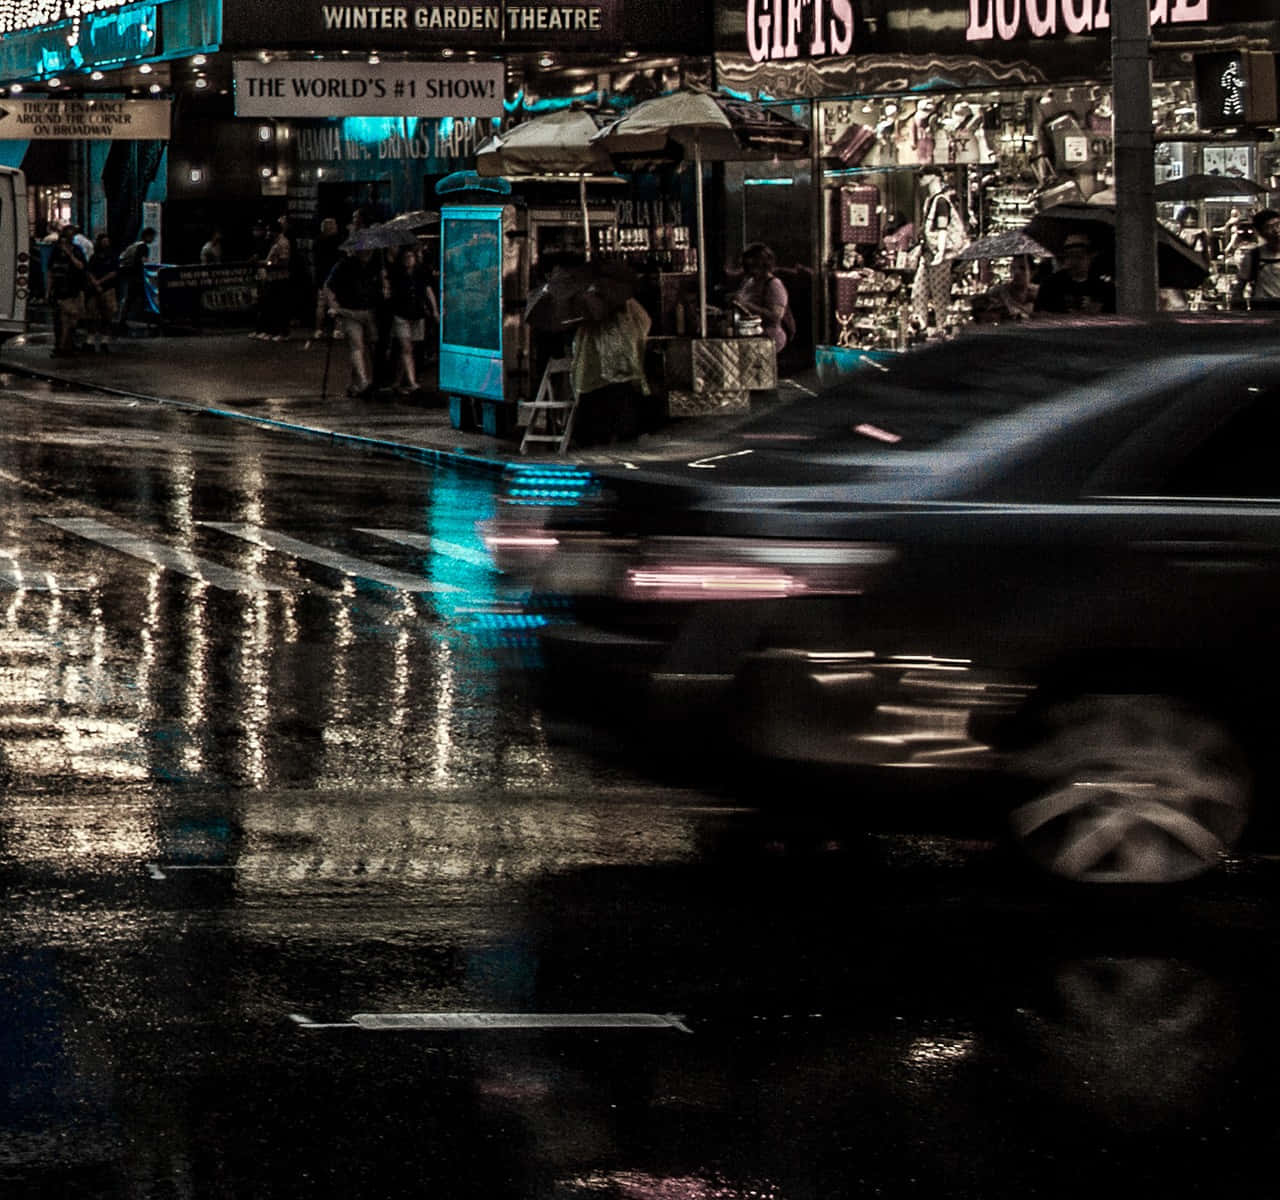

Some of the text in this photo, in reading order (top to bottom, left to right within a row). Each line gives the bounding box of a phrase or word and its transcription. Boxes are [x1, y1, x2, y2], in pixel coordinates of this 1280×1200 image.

[322, 5, 602, 30] WINTER GARDEN THEATRE
[246, 76, 496, 100] THE WORLD'S #1 SHOW!
[16, 113, 133, 125] AROUND THE CORNER
[33, 124, 113, 136] ON BROADWAY
